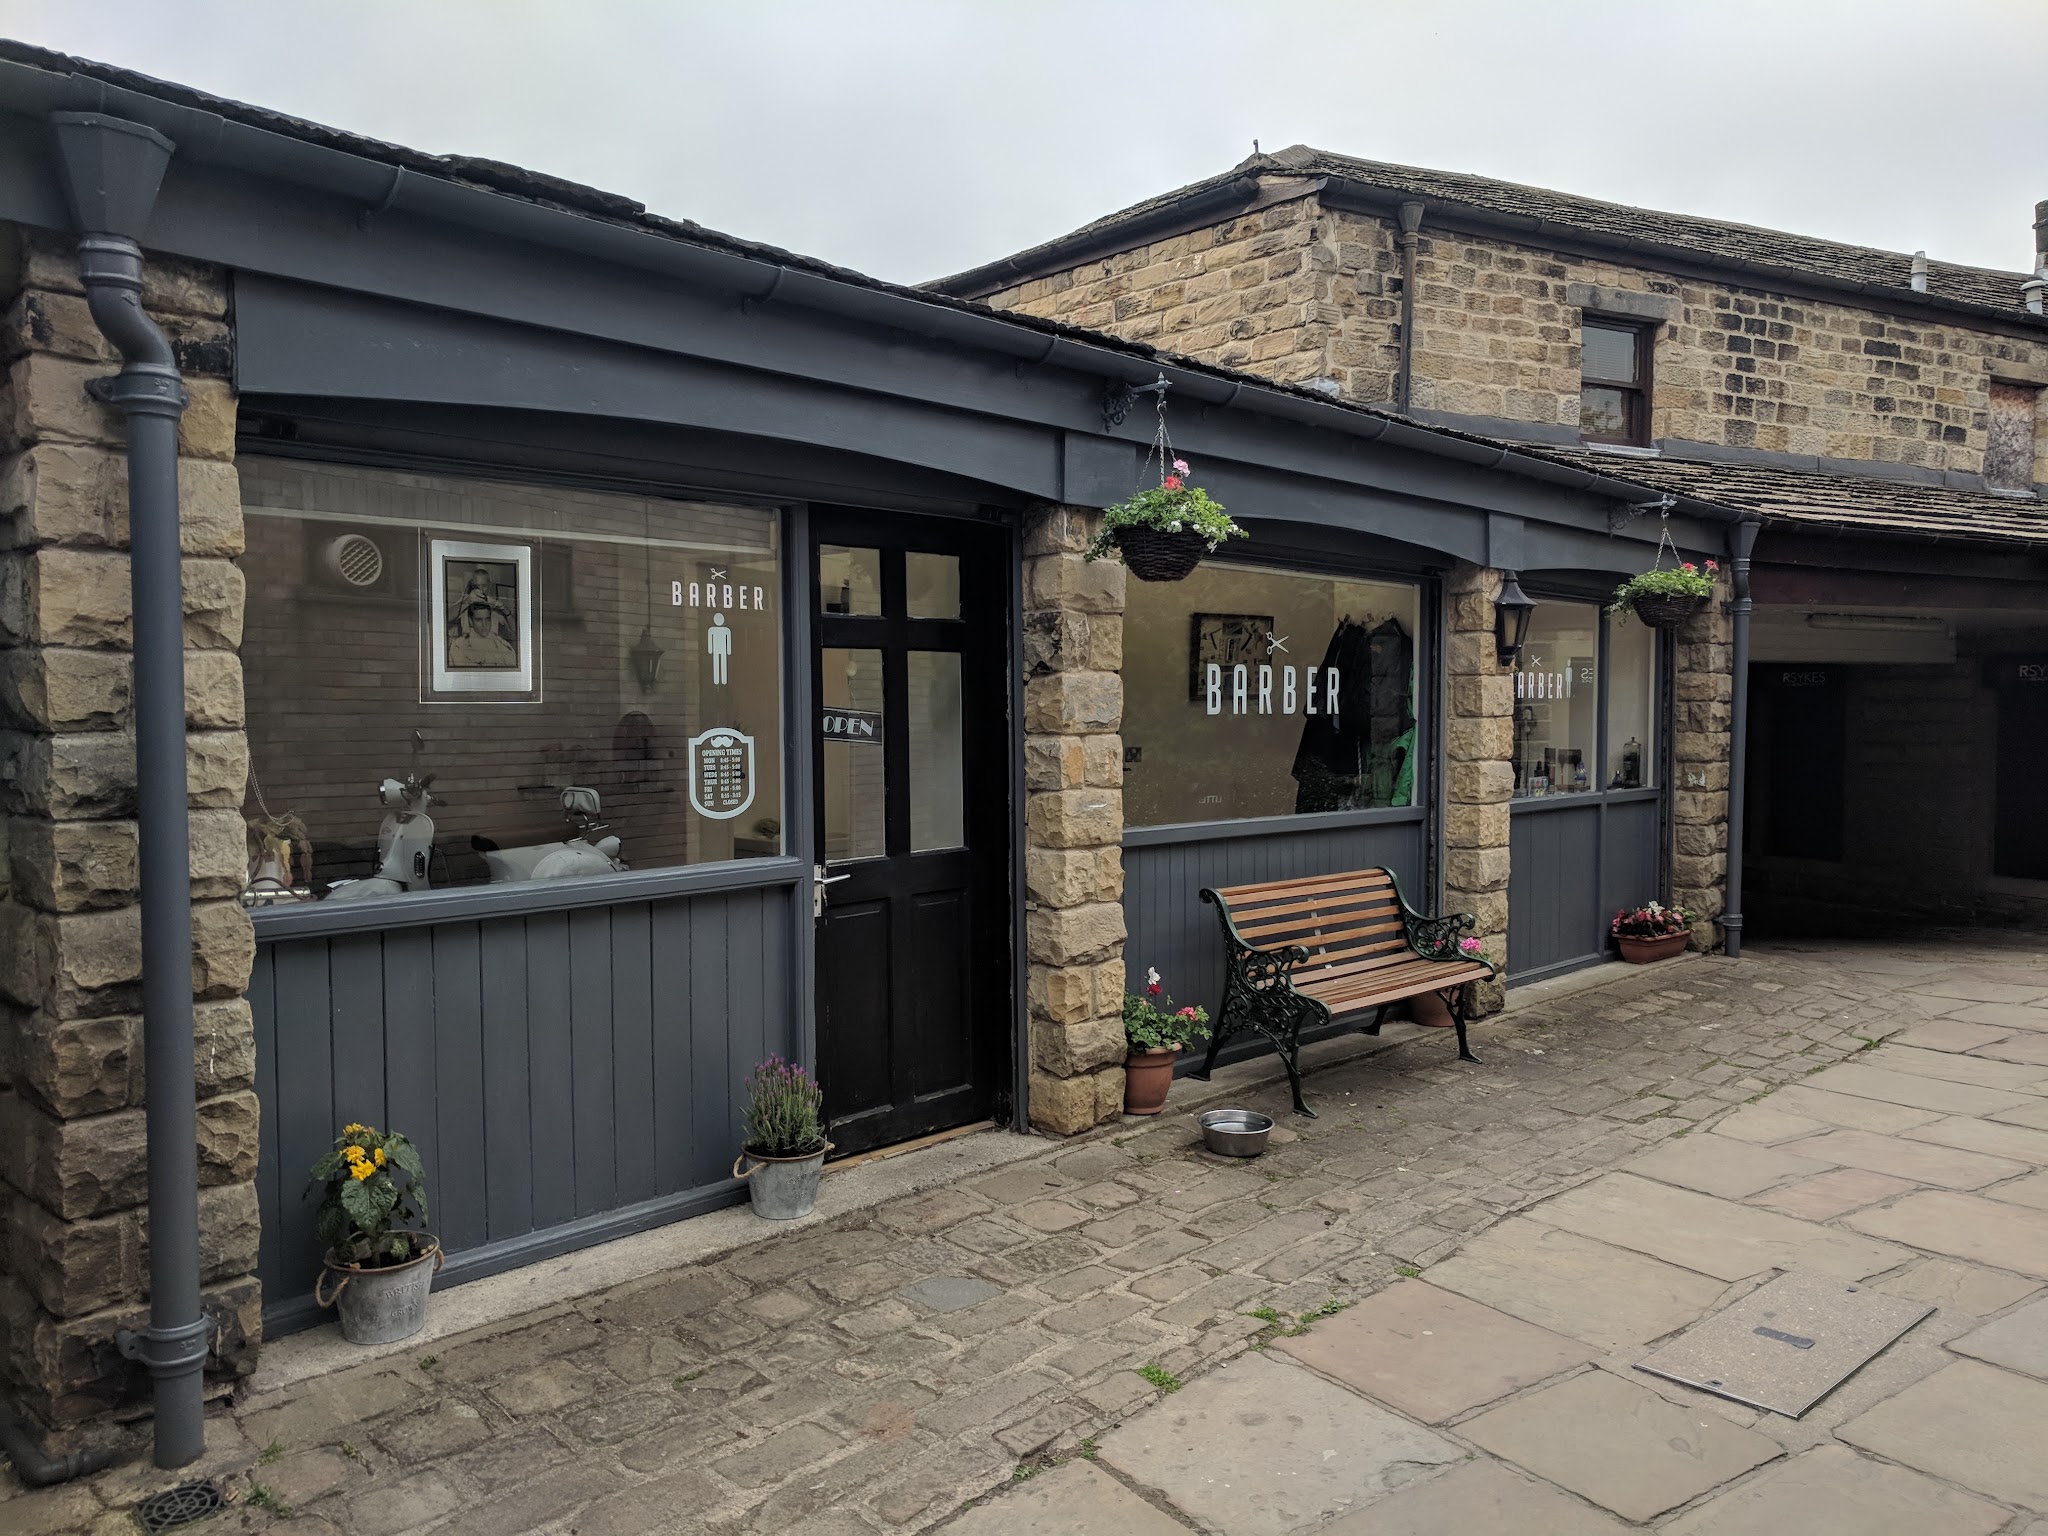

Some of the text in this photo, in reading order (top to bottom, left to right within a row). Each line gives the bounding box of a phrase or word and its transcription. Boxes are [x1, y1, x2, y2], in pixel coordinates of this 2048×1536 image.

[672, 581, 763, 610] BARBER
[1206, 664, 1340, 715] BARBER
[1510, 671, 1563, 699] ARBER
[823, 716, 874, 737] OPEN
[702, 749, 725, 757] OPENING
